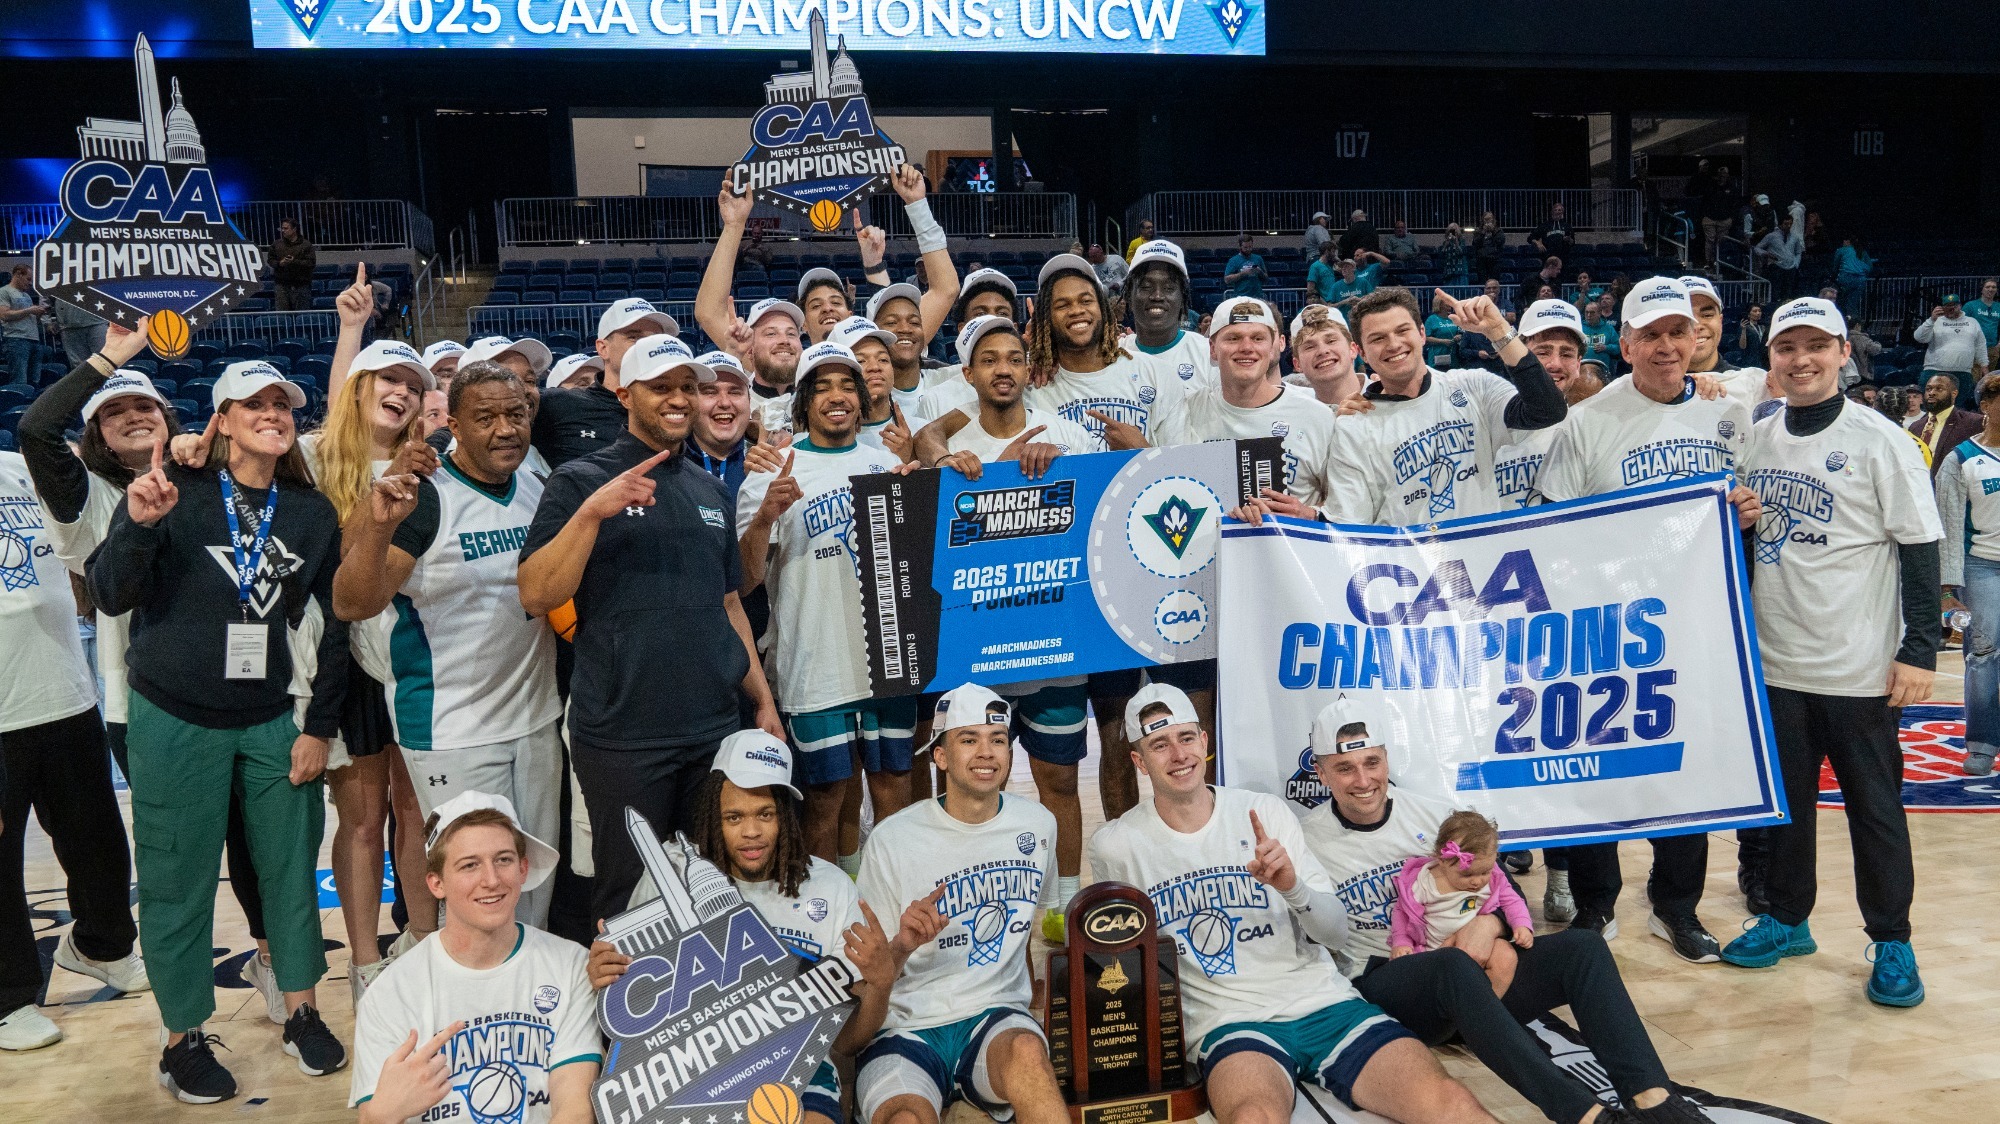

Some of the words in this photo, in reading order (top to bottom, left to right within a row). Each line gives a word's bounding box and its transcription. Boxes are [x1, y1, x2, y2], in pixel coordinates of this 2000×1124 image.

[364, 0, 501, 34] 2025
[516, 0, 640, 35] CAA
[650, 0, 1004, 39] CHAMPIONS:
[1018, 0, 1185, 41] UNCW
[753, 97, 875, 148] CAA
[770, 147, 800, 158] MEN'S
[802, 140, 865, 155] BASKETBALL
[1335, 130, 1370, 158] 107
[1854, 130, 1884, 156] 108
[733, 146, 906, 195] CHAMPIONSHIP
[65, 160, 225, 225] CAA
[793, 186, 838, 197] WASHINGTON,
[966, 180, 996, 193] TLC
[90, 227, 131, 239] MEN'S
[134, 228, 213, 240] BASKETBALL
[1141, 247, 1178, 259] CHAMPIONS
[37, 242, 263, 290] CHAMPIONSHIP
[124, 290, 182, 300] WASHINGTON,
[183, 290, 199, 298] D.C.
[1641, 291, 1685, 303] CHAMPIONS
[1536, 311, 1577, 322] CHAMPIONS
[1778, 309, 1826, 323] CHAMPIONS
[808, 349, 849, 361] CHAMPIONS
[1082, 397, 1143, 408] BASKETBALL
[1628, 441, 1663, 457] MEN'S
[1665, 437, 1729, 451] BASKETBALL
[1495, 455, 1528, 469] MEN'S
[1241, 449, 1253, 503] QUALIFIER
[1456, 463, 1480, 482] CAA
[1750, 467, 1769, 476] EN'S
[1770, 467, 1827, 490] BASKETBALL
[807, 488, 838, 507] MEN'S
[891, 483, 902, 497] 25
[1403, 488, 1428, 505] 2025
[1747, 473, 1835, 524] HAMPIONS
[893, 498, 905, 524] SEAT
[959, 502, 975, 510] NCAA
[976, 489, 1041, 514] MARCH
[986, 506, 1072, 533] MADNESS
[458, 526, 531, 562] SEAHA
[1789, 531, 1828, 546] CAA
[34, 543, 54, 558] CA
[814, 545, 842, 560] 2025
[899, 560, 910, 573] 16
[952, 564, 1008, 591] 2025
[1013, 556, 1082, 584] TICKET
[901, 574, 912, 599] ROW
[1345, 548, 1552, 627] CAA
[971, 581, 1065, 612] PUNCHED
[1161, 609, 1201, 626] CAA
[906, 633, 916, 641] 3
[980, 637, 1062, 656] #MARCHMADNESS
[1278, 597, 1667, 691] CHAMPIONS
[907, 642, 920, 686] SECTION
[971, 652, 1075, 674] @MARCHMADNESSMBB
[1494, 668, 1678, 754] 2025
[764, 746, 779, 754] CAA
[745, 751, 788, 771] CHAMPIONS
[1532, 754, 1601, 782] UNCW
[935, 867, 971, 888] MEN'S
[973, 859, 1038, 873] BASKETBALL
[1337, 871, 1369, 891] MEN'S
[936, 866, 1043, 919] HAMPIONS
[1147, 875, 1182, 895] MEN'S
[1150, 873, 1269, 929] HAMPIONS
[1009, 920, 1032, 934] CA
[1090, 911, 1142, 933] CAA
[772, 926, 815, 941] ETBALL
[938, 933, 968, 949] 2025
[1237, 923, 1274, 942] CAA
[603, 905, 789, 1039] CAA
[644, 1018, 692, 1052] MEN'S
[692, 971, 783, 1024] BASKETBALL
[1105, 1000, 1123, 1009] 2025
[1102, 1011, 1126, 1022] MEN'S
[1090, 1022, 1140, 1036] BASKETBALL
[597, 960, 853, 1124] CHAMPIONSHIP
[1093, 1034, 1138, 1048] CHAMPIONS
[1094, 1055, 1110, 1064] TOM
[1110, 1051, 1138, 1061] YEAGER
[1102, 1060, 1130, 1070] TROPHY
[706, 1058, 775, 1099] WASHINGTON,
[771, 1046, 792, 1062] D.C.
[421, 1101, 461, 1123] 2025
[1099, 1112, 1122, 1122] NORTH
[1121, 1108, 1154, 1120] CAROLINA
[1103, 1104, 1140, 1115] UNIVERSITY
[1140, 1102, 1149, 1110] OF
